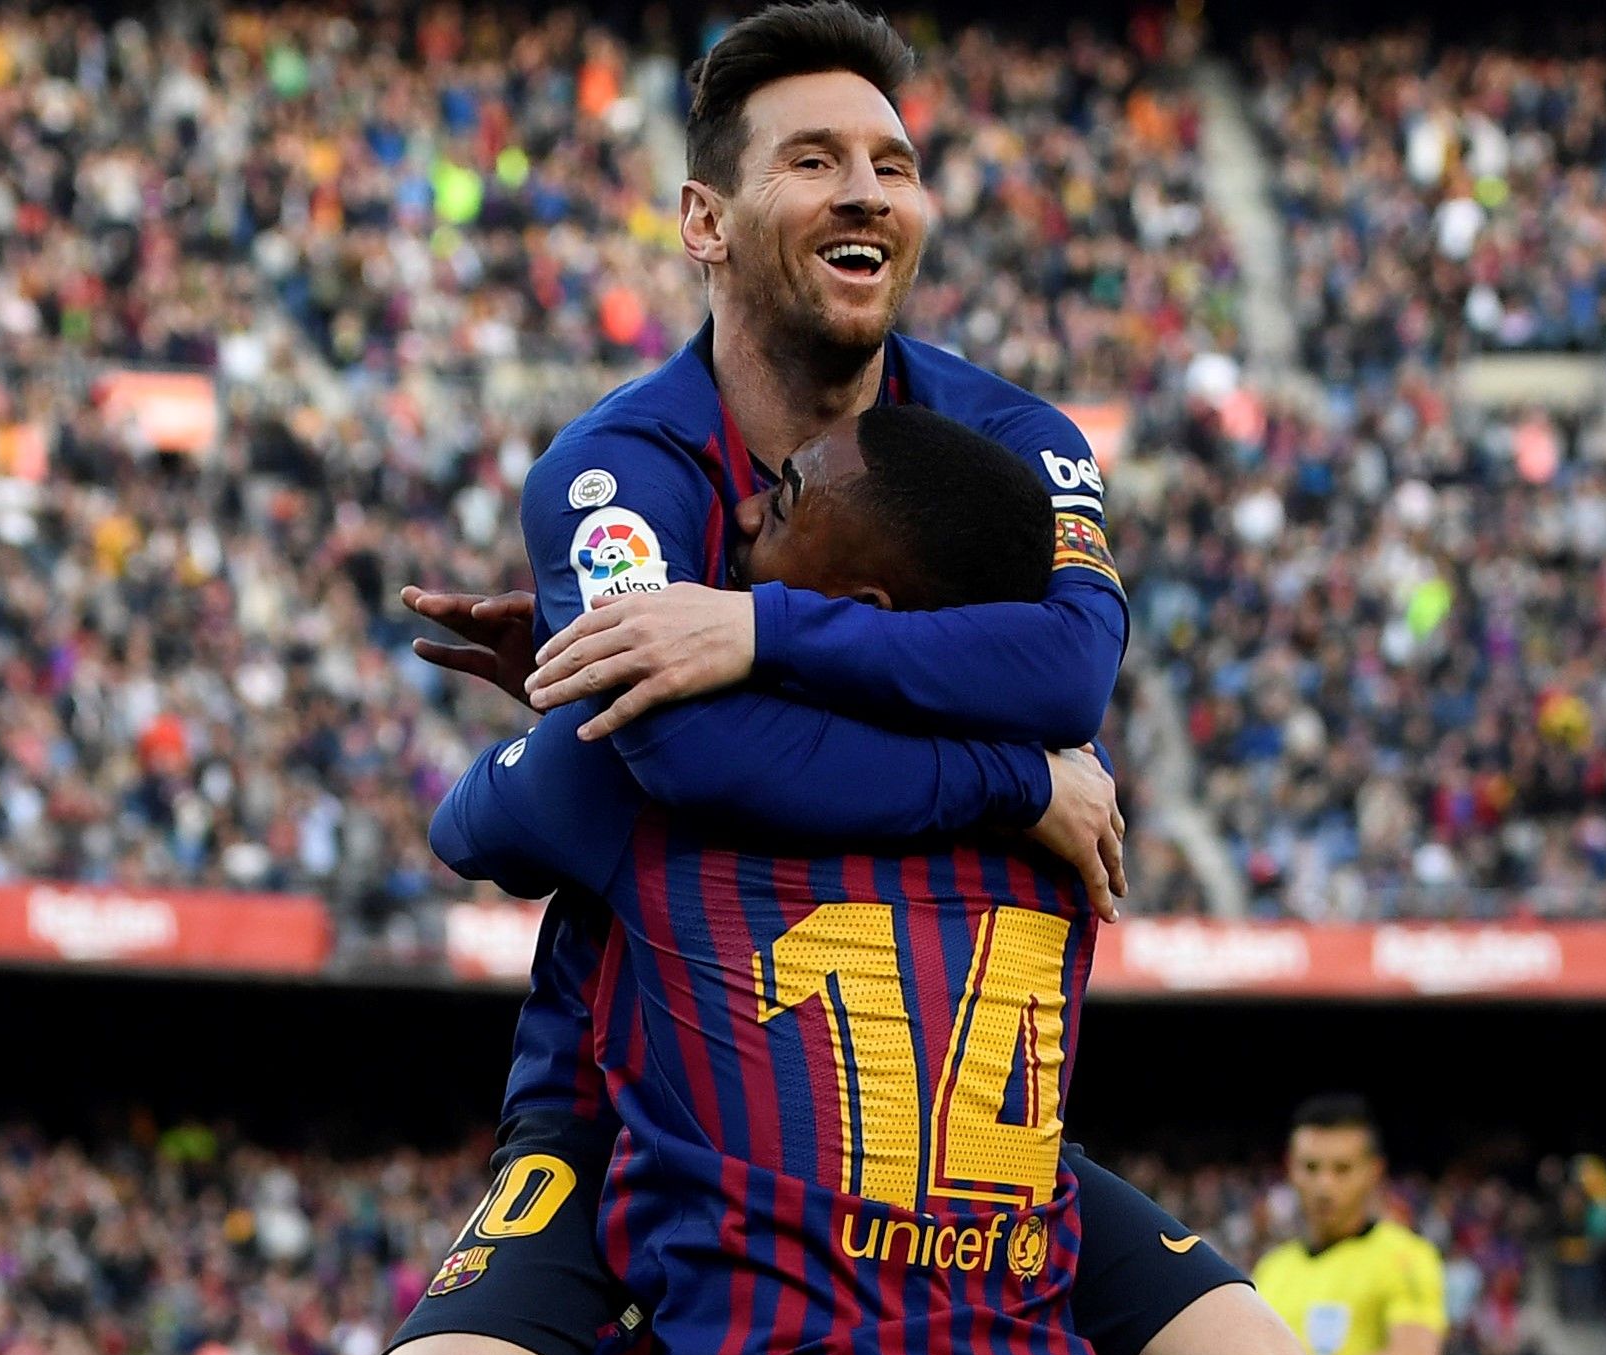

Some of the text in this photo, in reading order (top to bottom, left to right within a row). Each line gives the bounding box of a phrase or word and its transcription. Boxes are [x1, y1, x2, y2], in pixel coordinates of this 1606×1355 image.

[751, 902, 1072, 1213] 14
[450, 1154, 577, 1250] 0
[841, 1212, 1007, 1273] unicef
